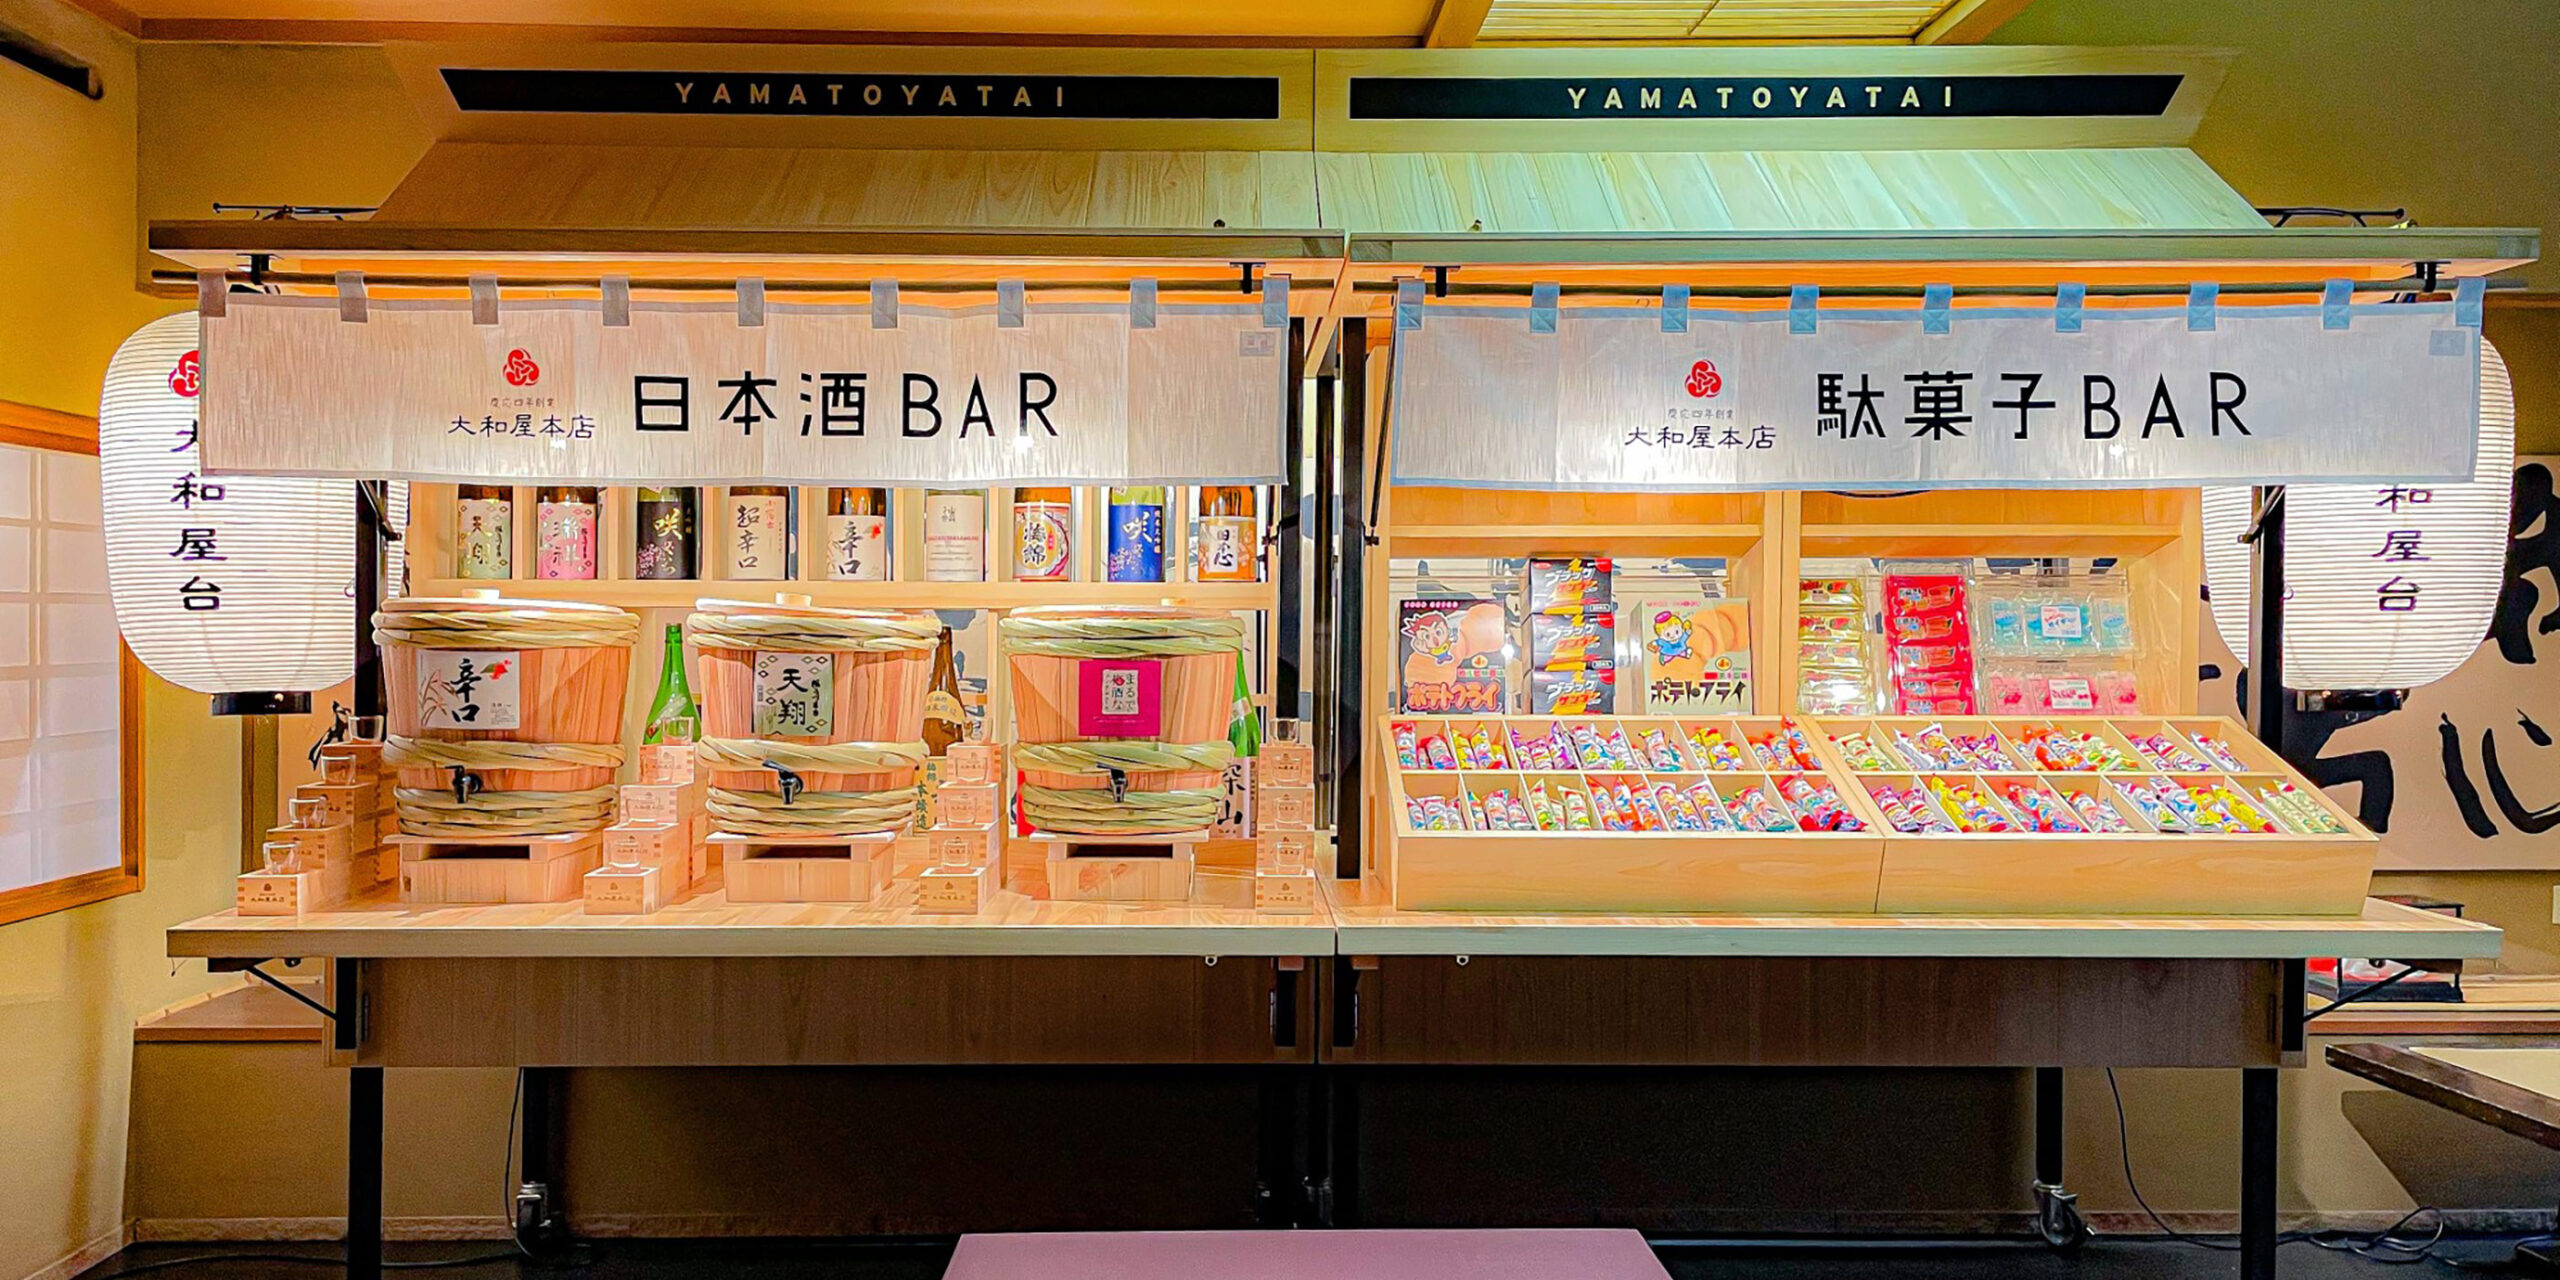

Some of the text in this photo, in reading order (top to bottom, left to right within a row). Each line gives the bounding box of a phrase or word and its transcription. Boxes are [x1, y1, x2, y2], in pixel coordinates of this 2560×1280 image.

[675, 83, 1063, 107] YAMATOYATAI
[1568, 86, 1952, 109] YAMATOYATAI
[447, 414, 596, 439] 大和屋本店
[1624, 425, 1777, 449] 大和屋本店
[736, 504, 761, 569] 超辛口
[838, 520, 863, 576] 辛口
[449, 657, 482, 723] 辛口
[776, 668, 809, 726] 天翔
[1407, 681, 1500, 711] ポテトフライ
[1650, 676, 1747, 706] ポテトフライ
